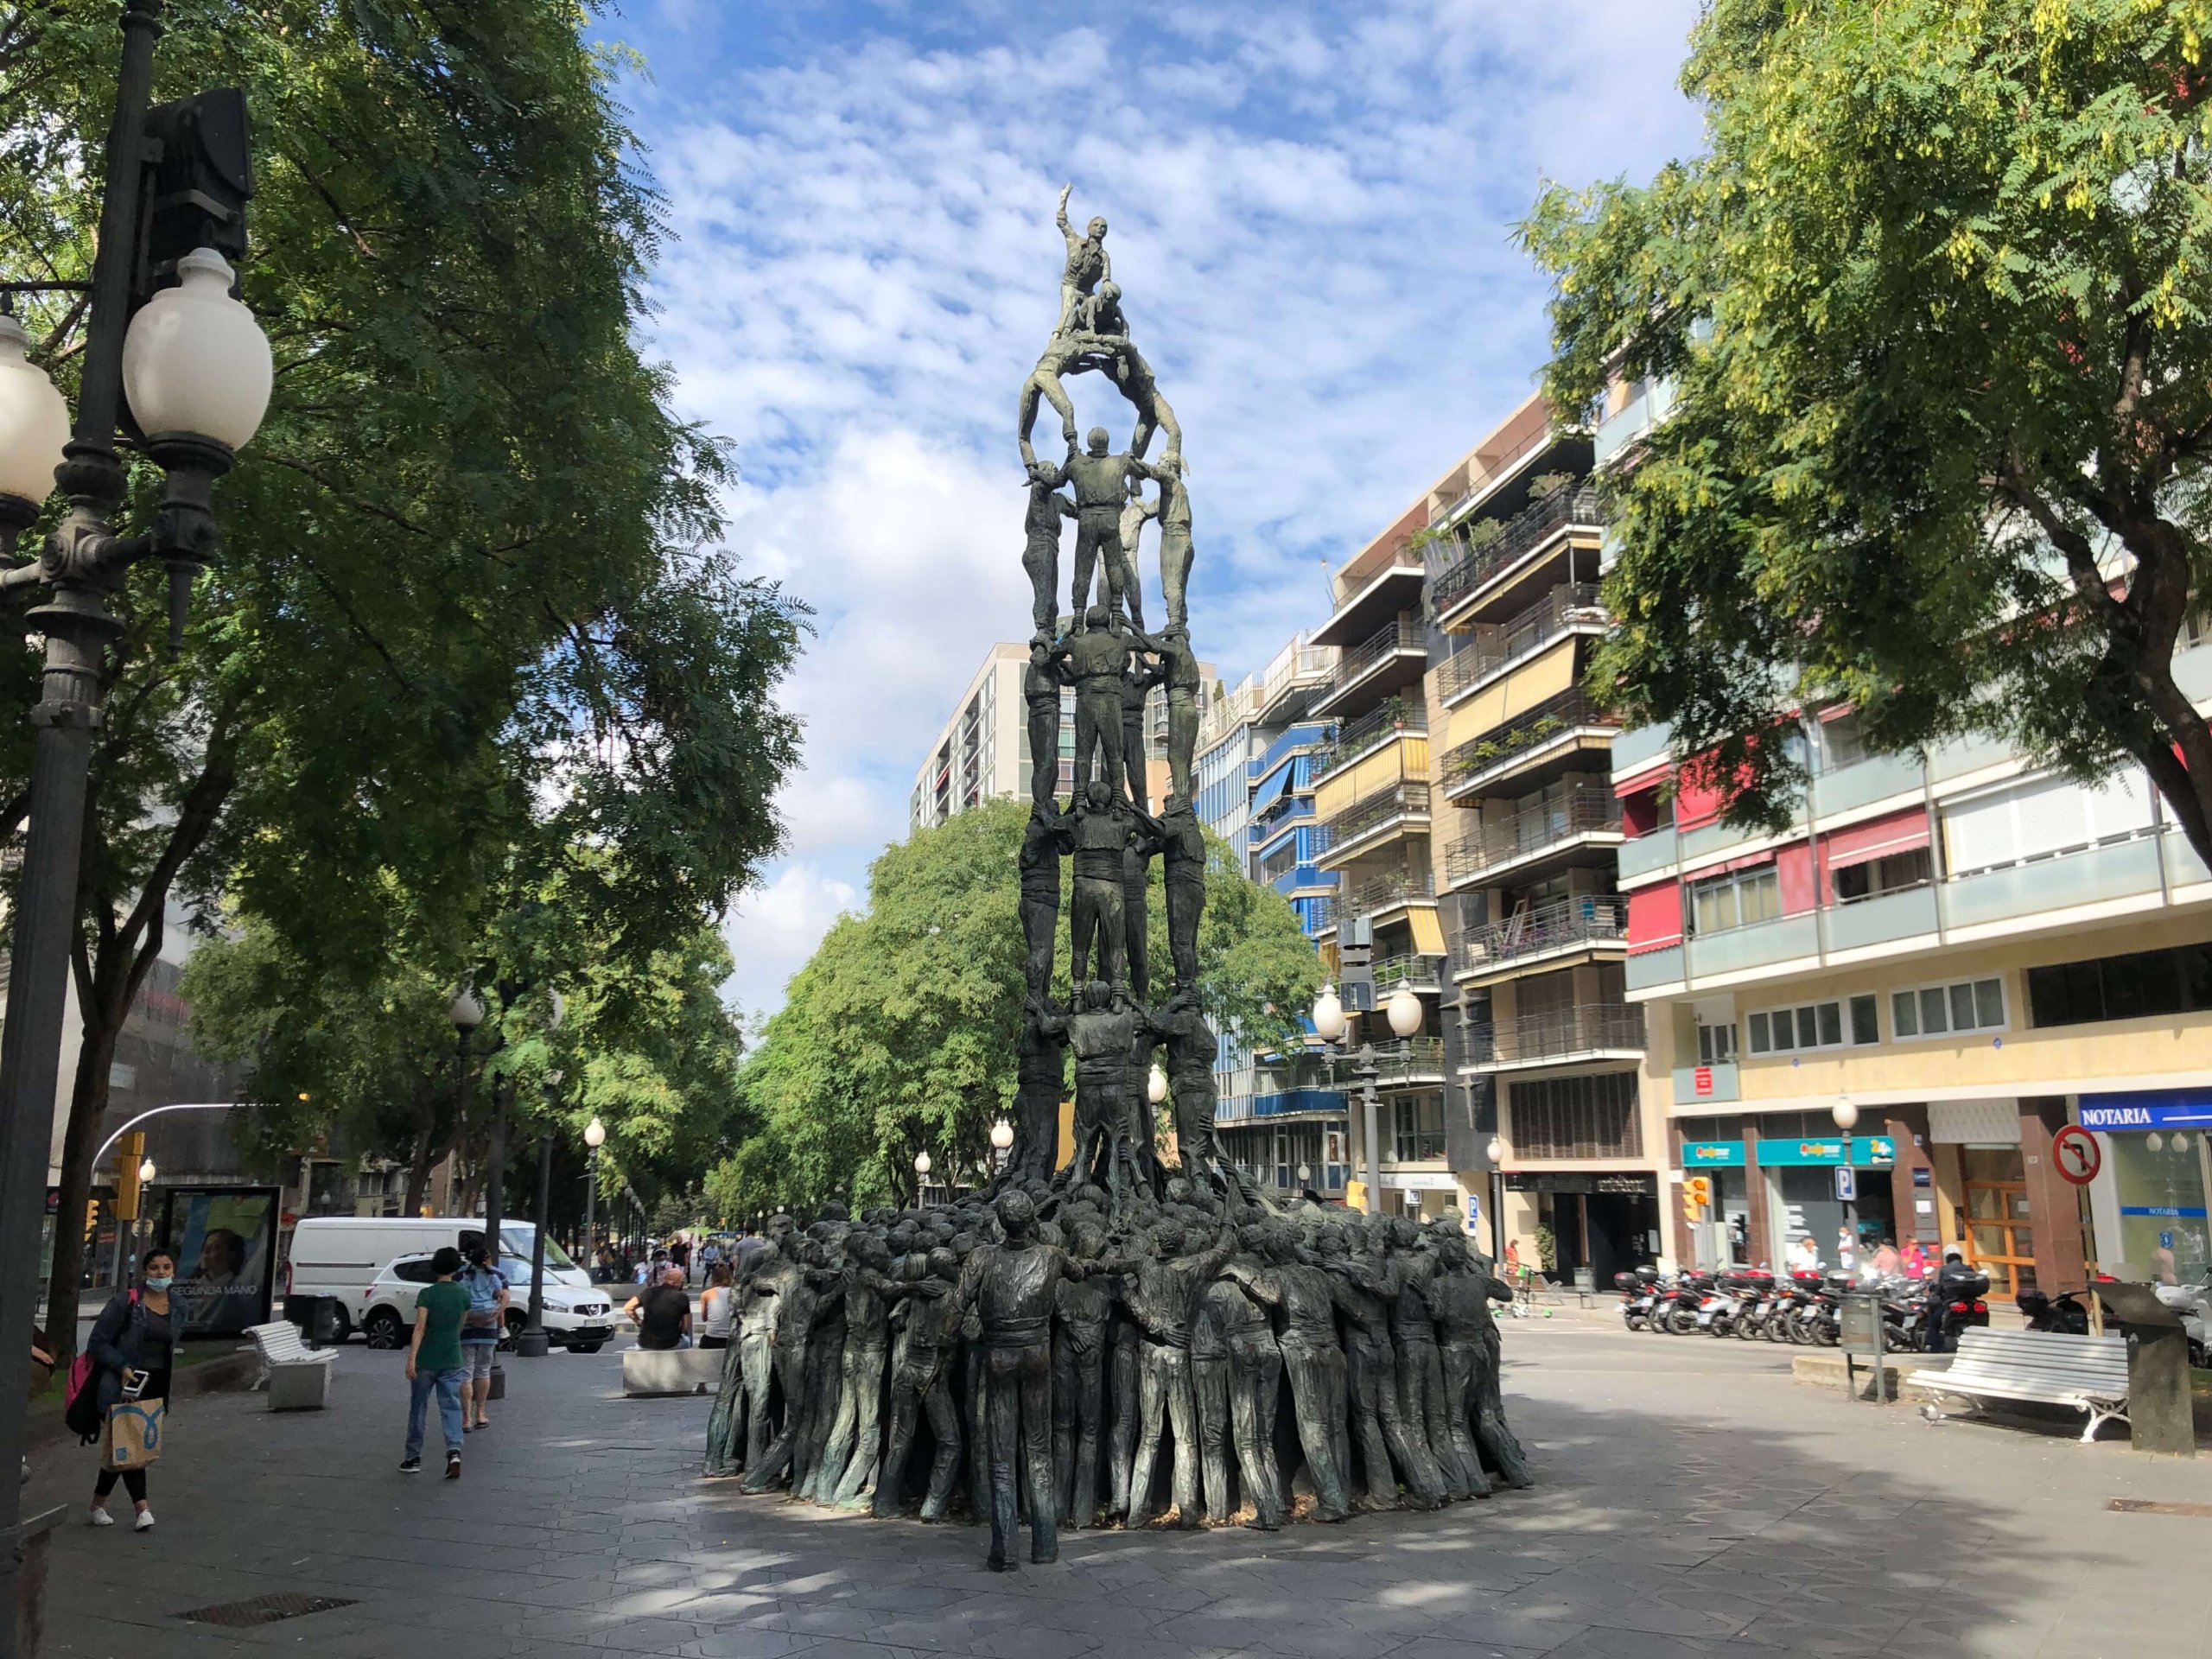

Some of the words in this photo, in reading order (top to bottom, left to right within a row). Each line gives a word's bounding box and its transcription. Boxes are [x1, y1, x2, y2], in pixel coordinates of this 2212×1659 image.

[2082, 1107, 2152, 1126] NOTARIA
[2148, 1207, 2180, 1216] NOTARIA
[225, 1285, 257, 1294] MANO
